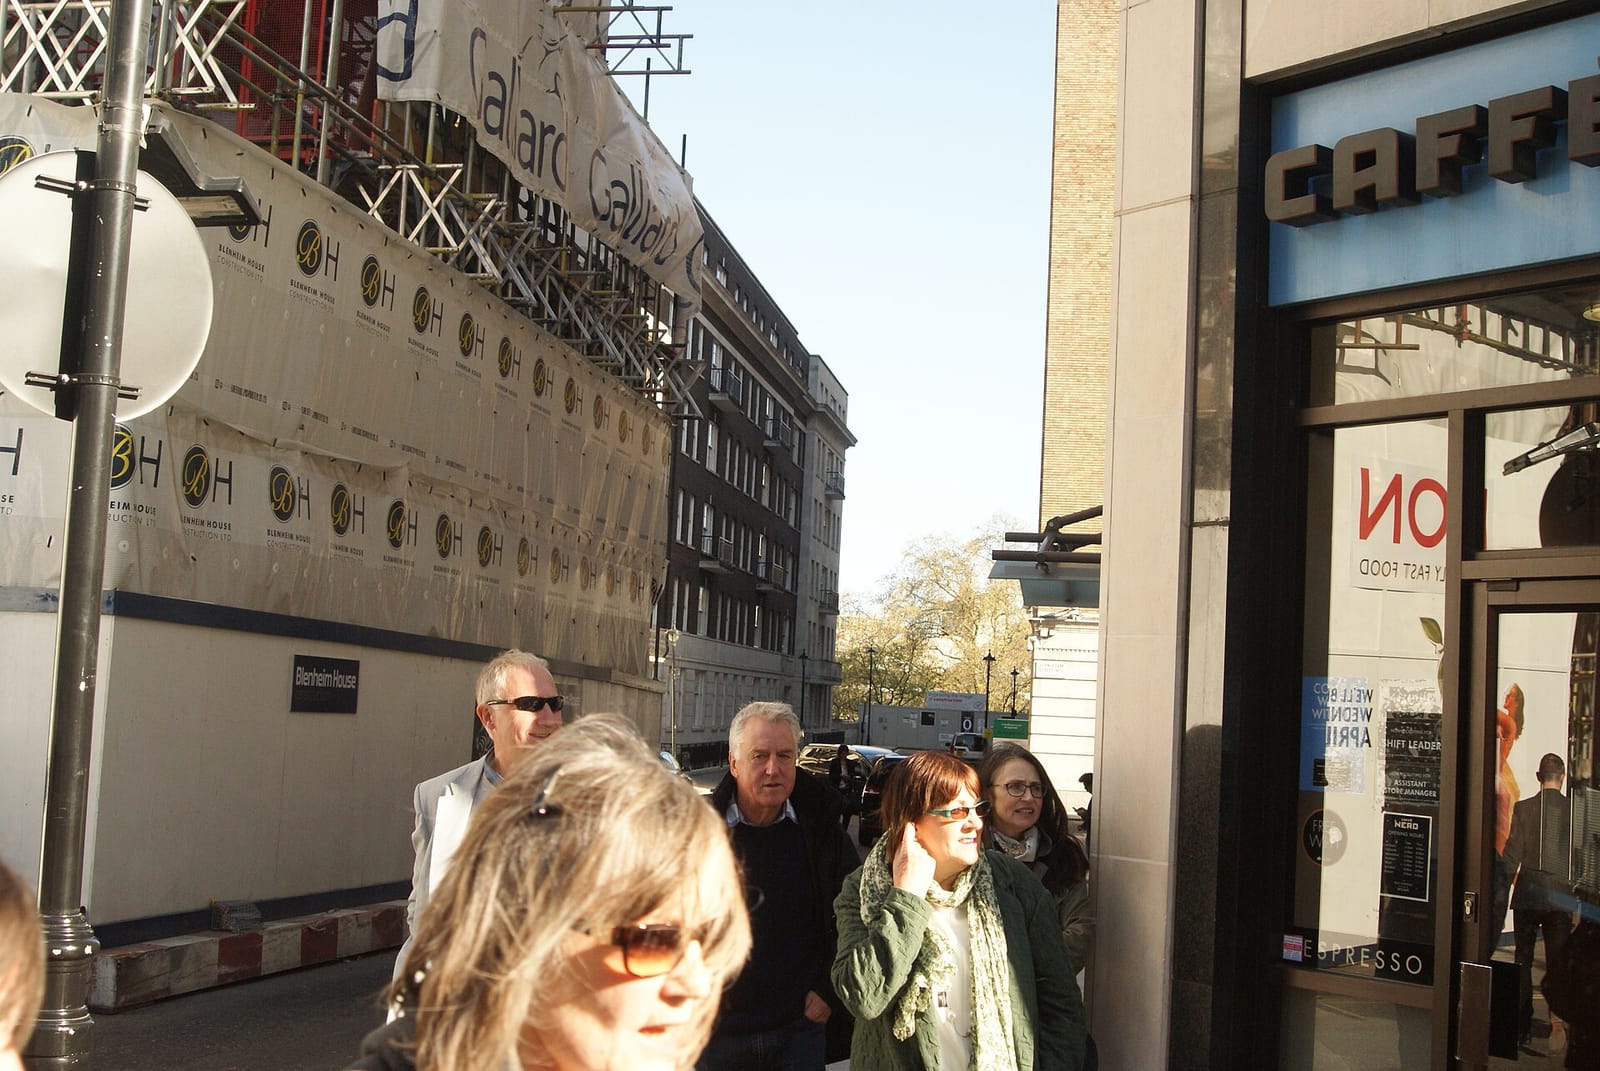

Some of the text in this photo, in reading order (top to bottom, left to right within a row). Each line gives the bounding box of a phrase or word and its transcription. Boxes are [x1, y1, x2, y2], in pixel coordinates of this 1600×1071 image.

[295, 666, 357, 689] Blenheim House
[1408, 740, 1442, 751] LEADER
[1393, 779, 1427, 788] ASSISTANT
[1404, 788, 1437, 798] MANAGER
[1304, 939, 1422, 975] ESPRESSO
